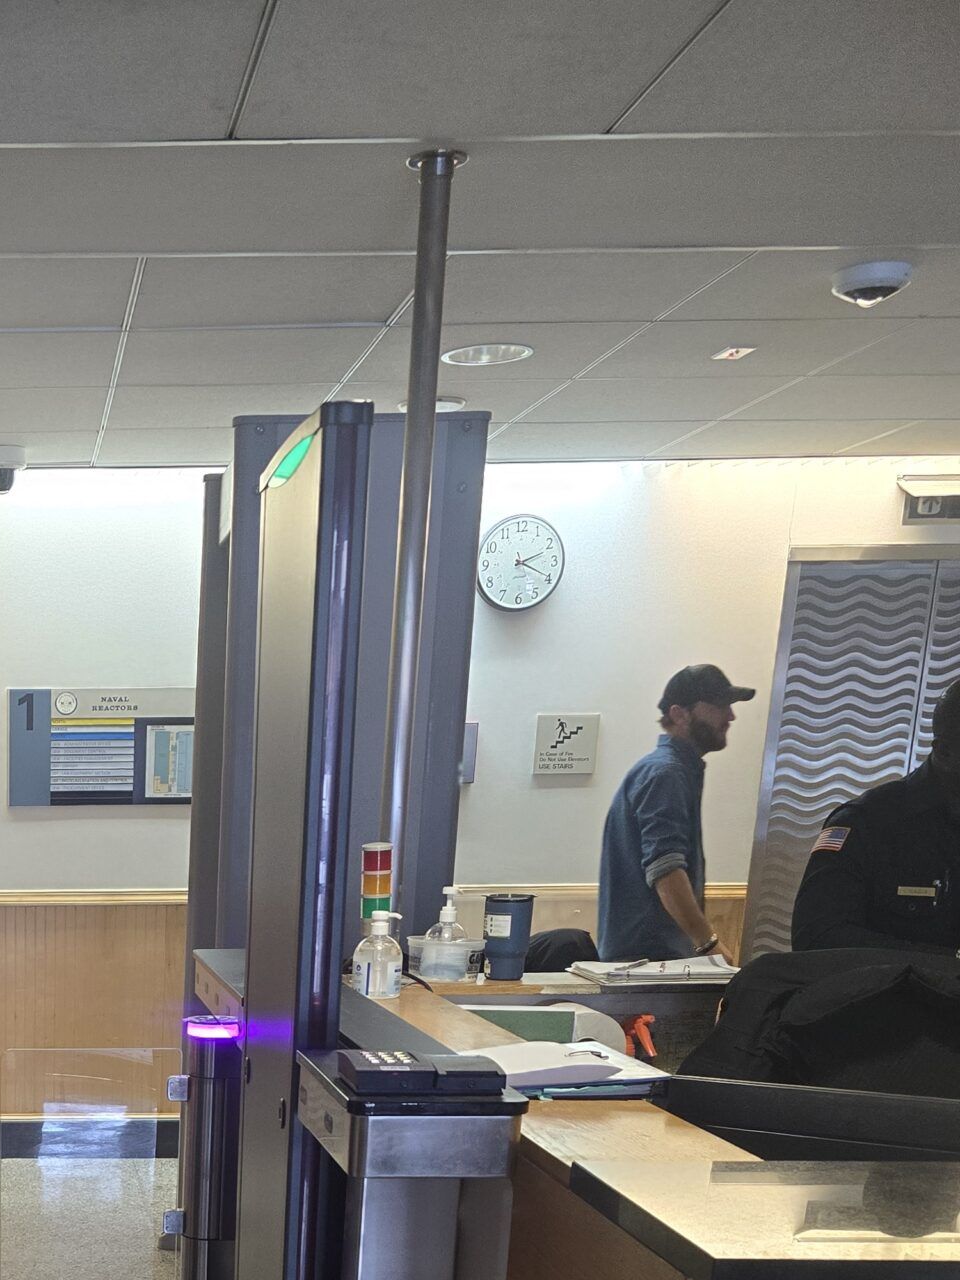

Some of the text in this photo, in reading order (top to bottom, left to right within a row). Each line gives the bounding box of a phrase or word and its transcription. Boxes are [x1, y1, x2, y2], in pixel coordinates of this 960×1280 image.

[516, 521, 528, 532] 12
[536, 526, 540, 537] 1
[501, 528, 509, 539] 11
[486, 541, 497, 553] 10
[546, 538, 553, 549] 2
[482, 560, 489, 572] 9
[551, 555, 558, 567] 3
[486, 576, 493, 588] 8
[545, 573, 552, 584] 4
[499, 590, 506, 602] 7
[515, 593, 522, 604] 6
[531, 587, 539, 599] 5
[17, 693, 34, 731] 1
